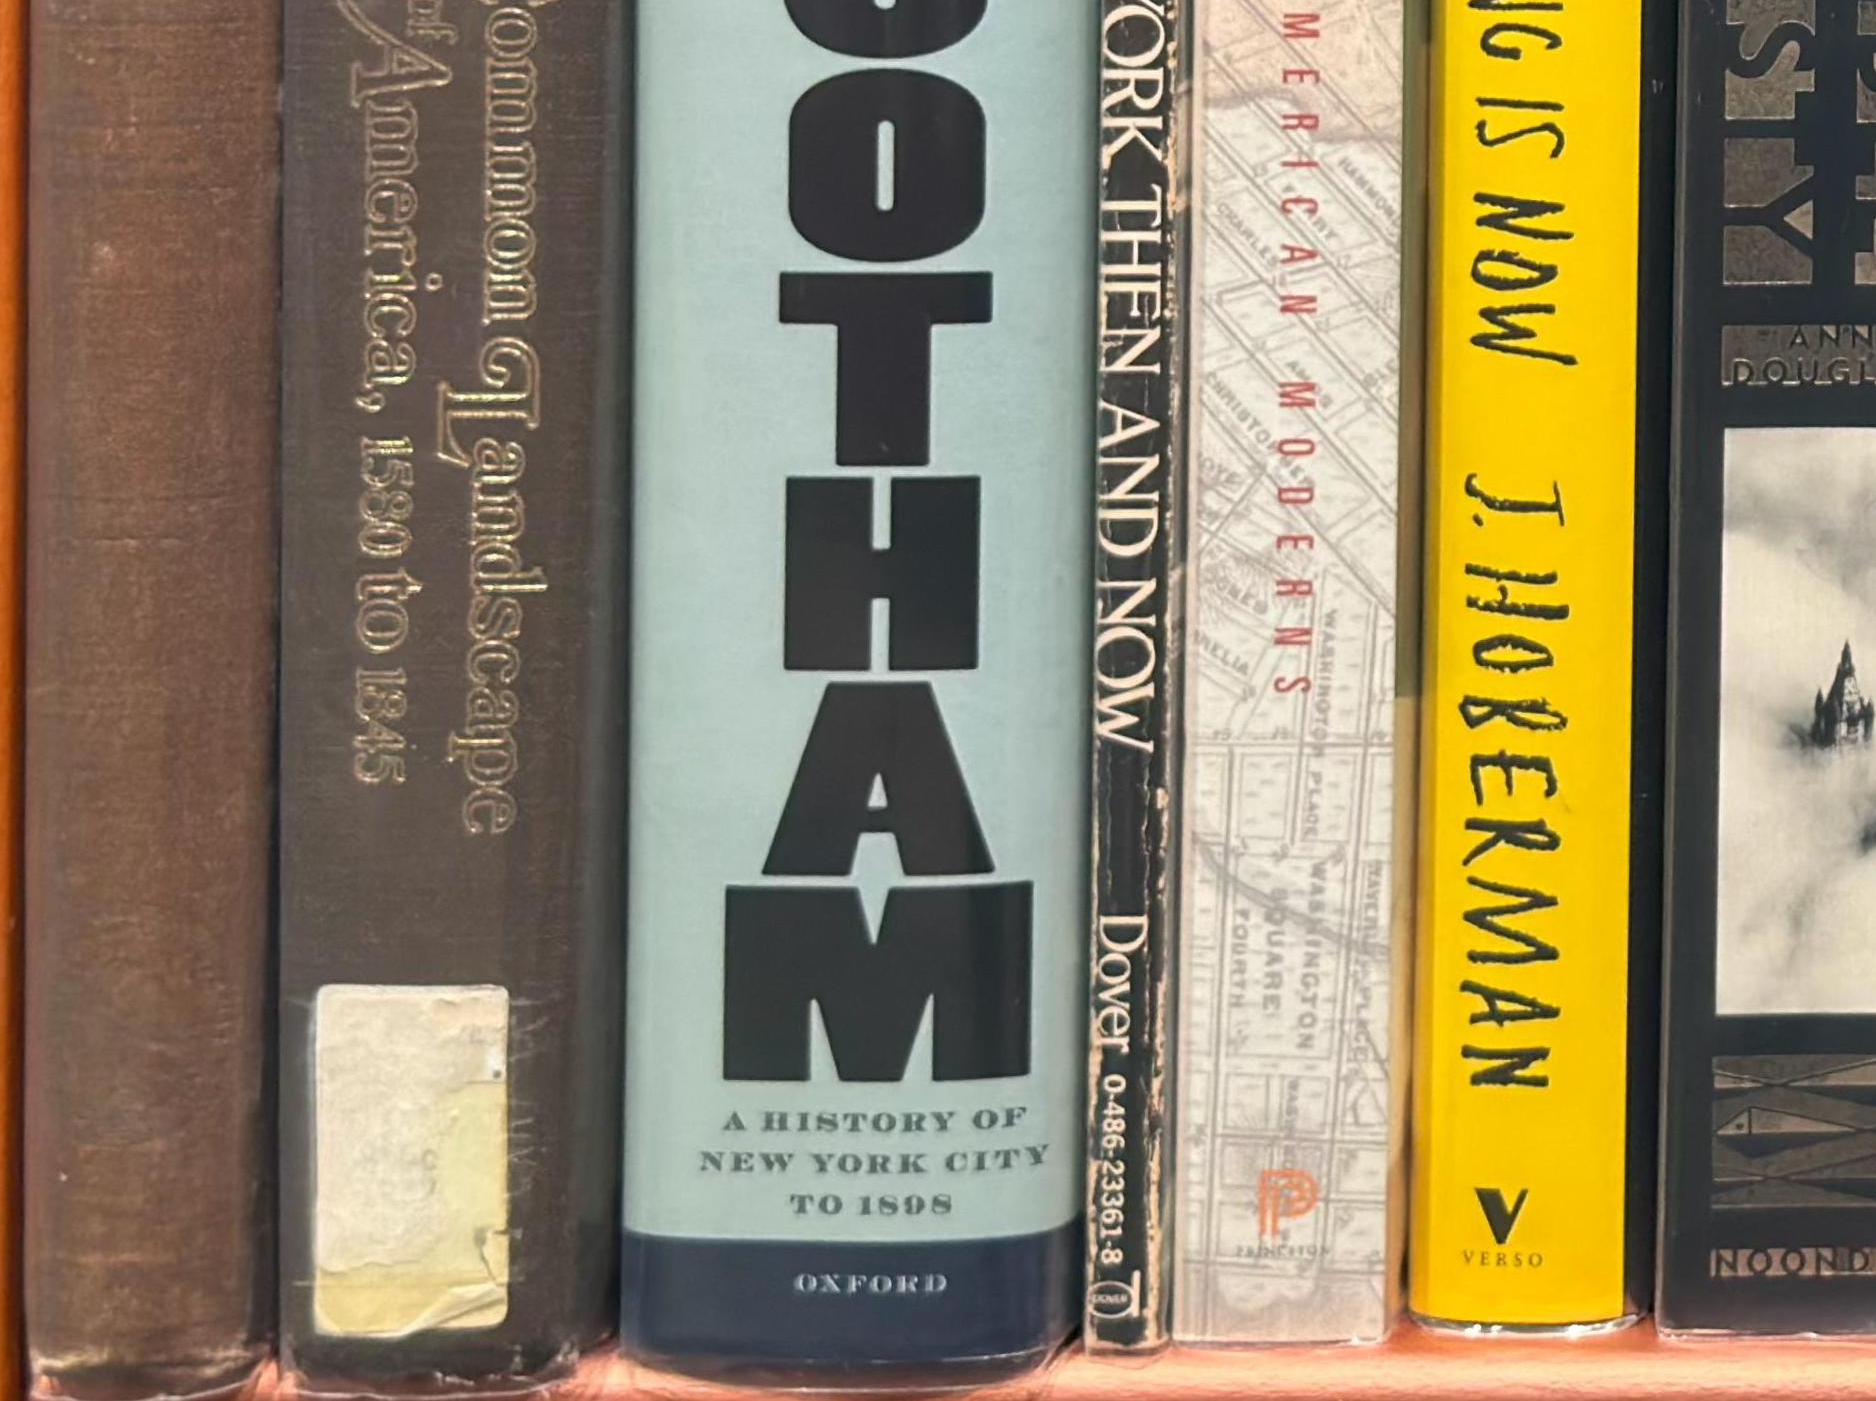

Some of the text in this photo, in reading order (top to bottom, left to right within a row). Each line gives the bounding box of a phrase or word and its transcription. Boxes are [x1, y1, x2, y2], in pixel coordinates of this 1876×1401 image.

[1474, 95, 1567, 161] IS
[1098, 185, 1163, 375] THEN
[1469, 191, 1579, 368] NOW
[1787, 325, 1876, 351] ANN
[357, 438, 413, 556] 1580
[1096, 401, 1161, 559] AND
[1273, 381, 1317, 695] MODERNS
[358, 567, 424, 654] to
[436, 336, 548, 837] Landscape
[1094, 576, 1158, 753] NOW
[353, 666, 409, 787] 1845
[1459, 472, 1570, 1092] J. HOBERMAN
[1296, 861, 1328, 1050] WASHINGTON
[722, 1106, 1029, 1135] A HISTORY OF
[1097, 913, 1150, 1266] Dover 0-486-23361-8
[700, 1142, 1052, 1175] NEW YORK CITY
[789, 1193, 953, 1217] TO 1898
[793, 1272, 949, 1294] OXFORD
[1459, 1248, 1546, 1269] VERSO
